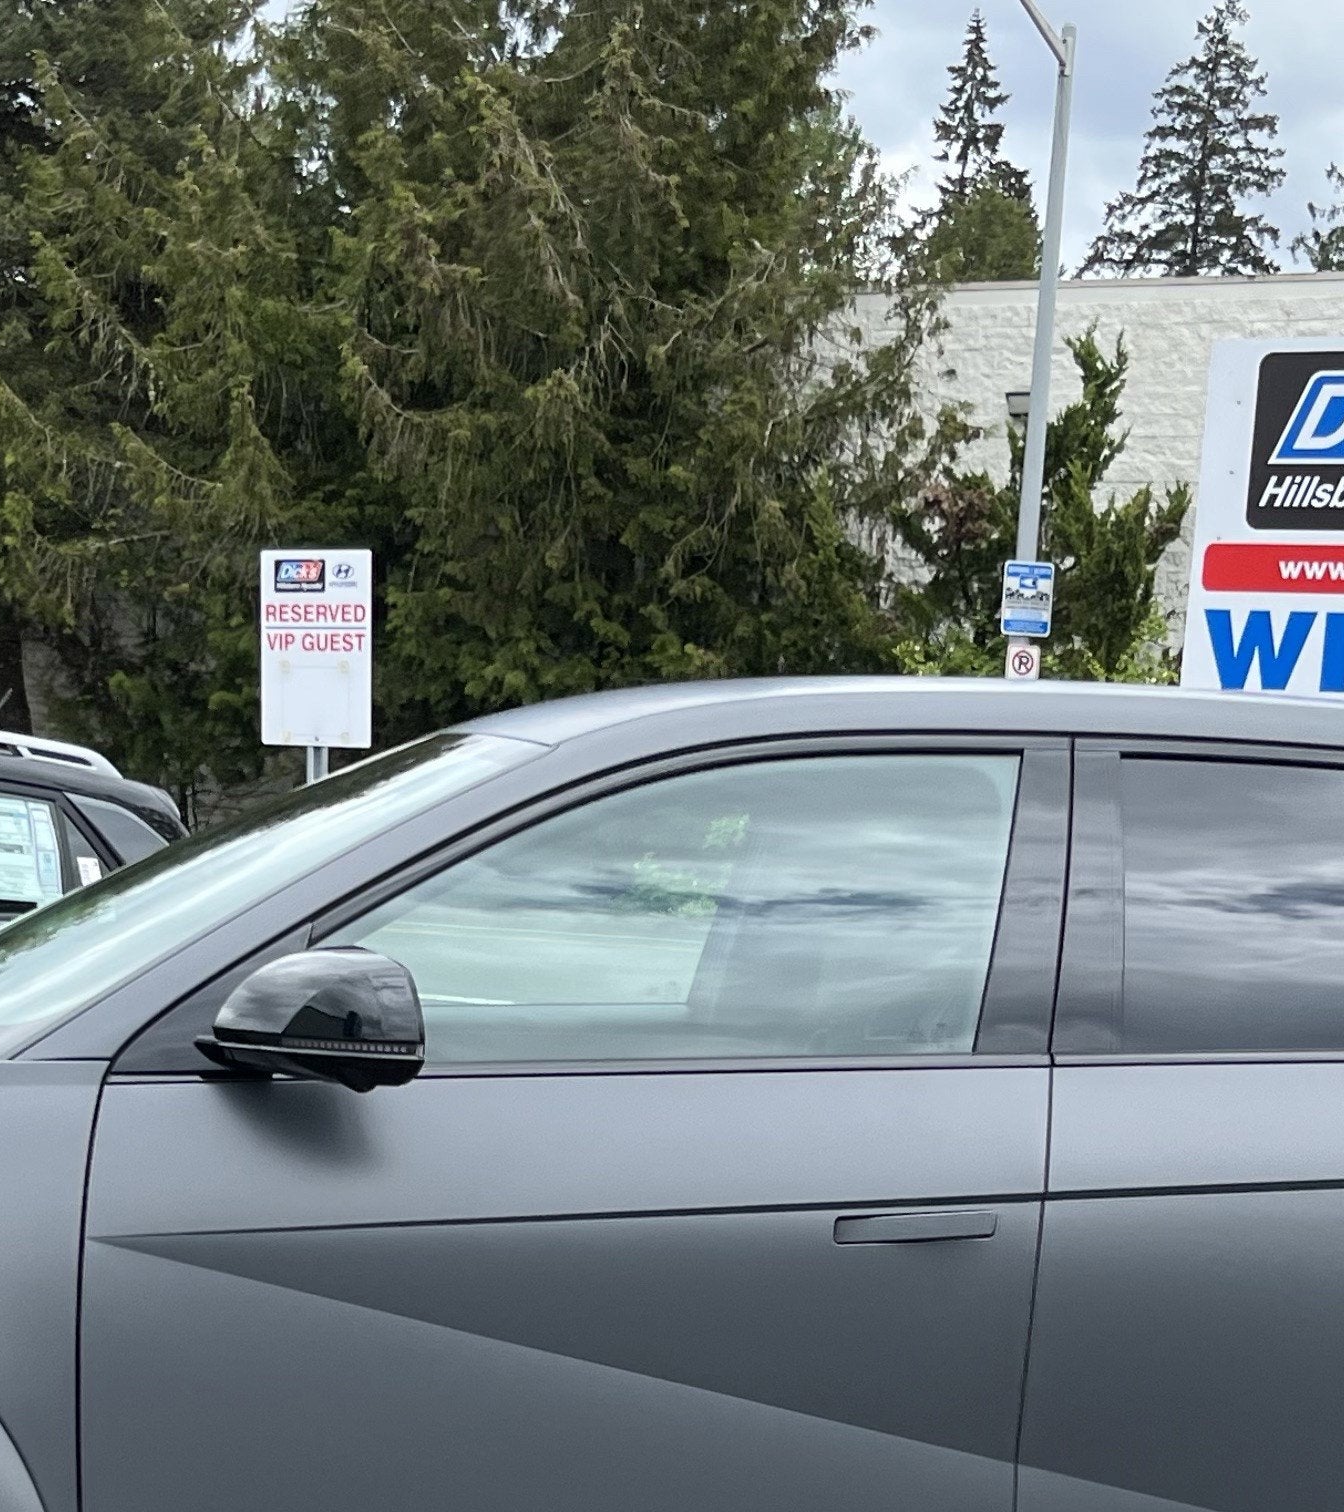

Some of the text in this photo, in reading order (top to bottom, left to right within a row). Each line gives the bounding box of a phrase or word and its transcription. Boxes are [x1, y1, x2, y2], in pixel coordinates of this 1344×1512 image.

[266, 604, 366, 622] RESERVED
[267, 633, 365, 651] VIP GUEST
